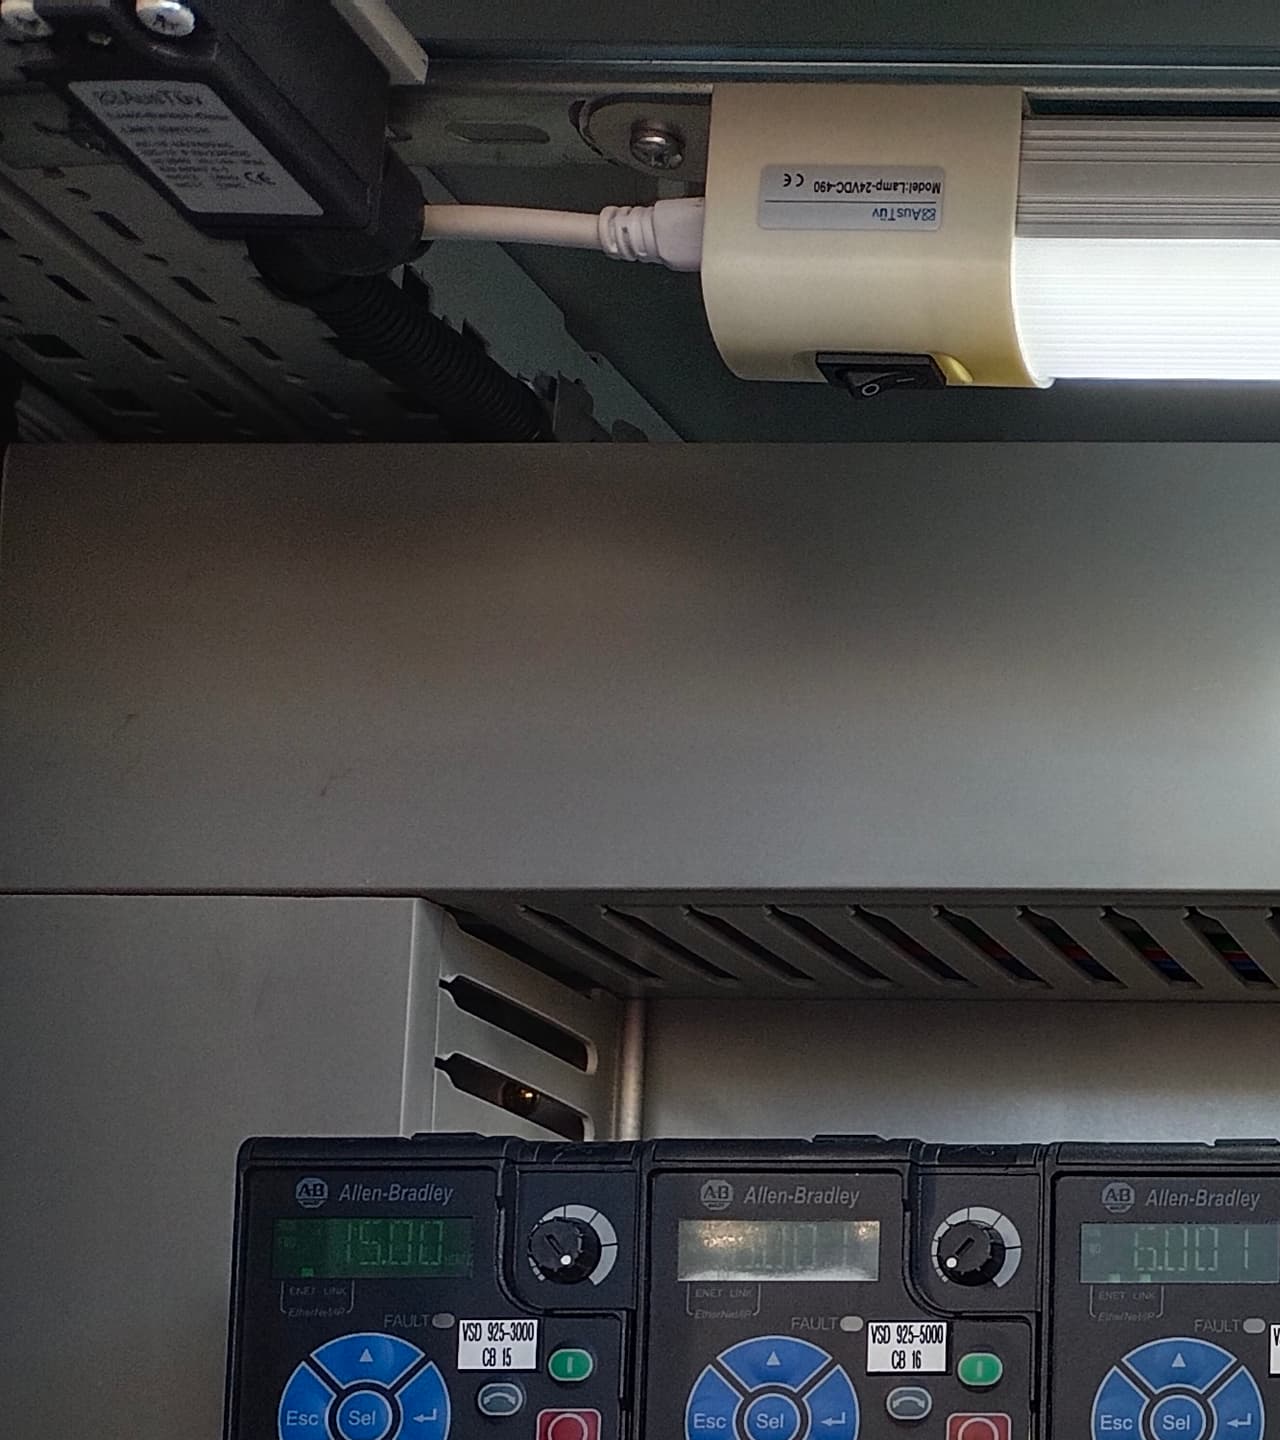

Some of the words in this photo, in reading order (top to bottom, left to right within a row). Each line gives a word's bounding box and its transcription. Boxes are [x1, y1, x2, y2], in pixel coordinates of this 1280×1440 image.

[338, 1184, 454, 1205] Allen-Bradley
[744, 1186, 860, 1208] Allen-Bradley
[1145, 1188, 1260, 1210] Allen-Bradley
[384, 1314, 430, 1328] FAULT
[791, 1317, 837, 1330] FAULT
[1194, 1319, 1240, 1333] FAULT
[461, 1322, 482, 1342] VSD
[487, 1321, 534, 1341] 925-3000
[870, 1325, 891, 1344] VSD
[896, 1324, 944, 1343] 925-5000
[481, 1348, 496, 1367] CB
[499, 1348, 512, 1367] 15
[891, 1350, 906, 1369] CB
[911, 1350, 922, 1369] 16
[286, 1412, 319, 1426] Esc
[348, 1410, 376, 1426] Sel
[693, 1414, 727, 1428] Esc
[756, 1413, 784, 1428] Sel
[1100, 1416, 1133, 1430] Esc
[1162, 1415, 1191, 1430] Sel
